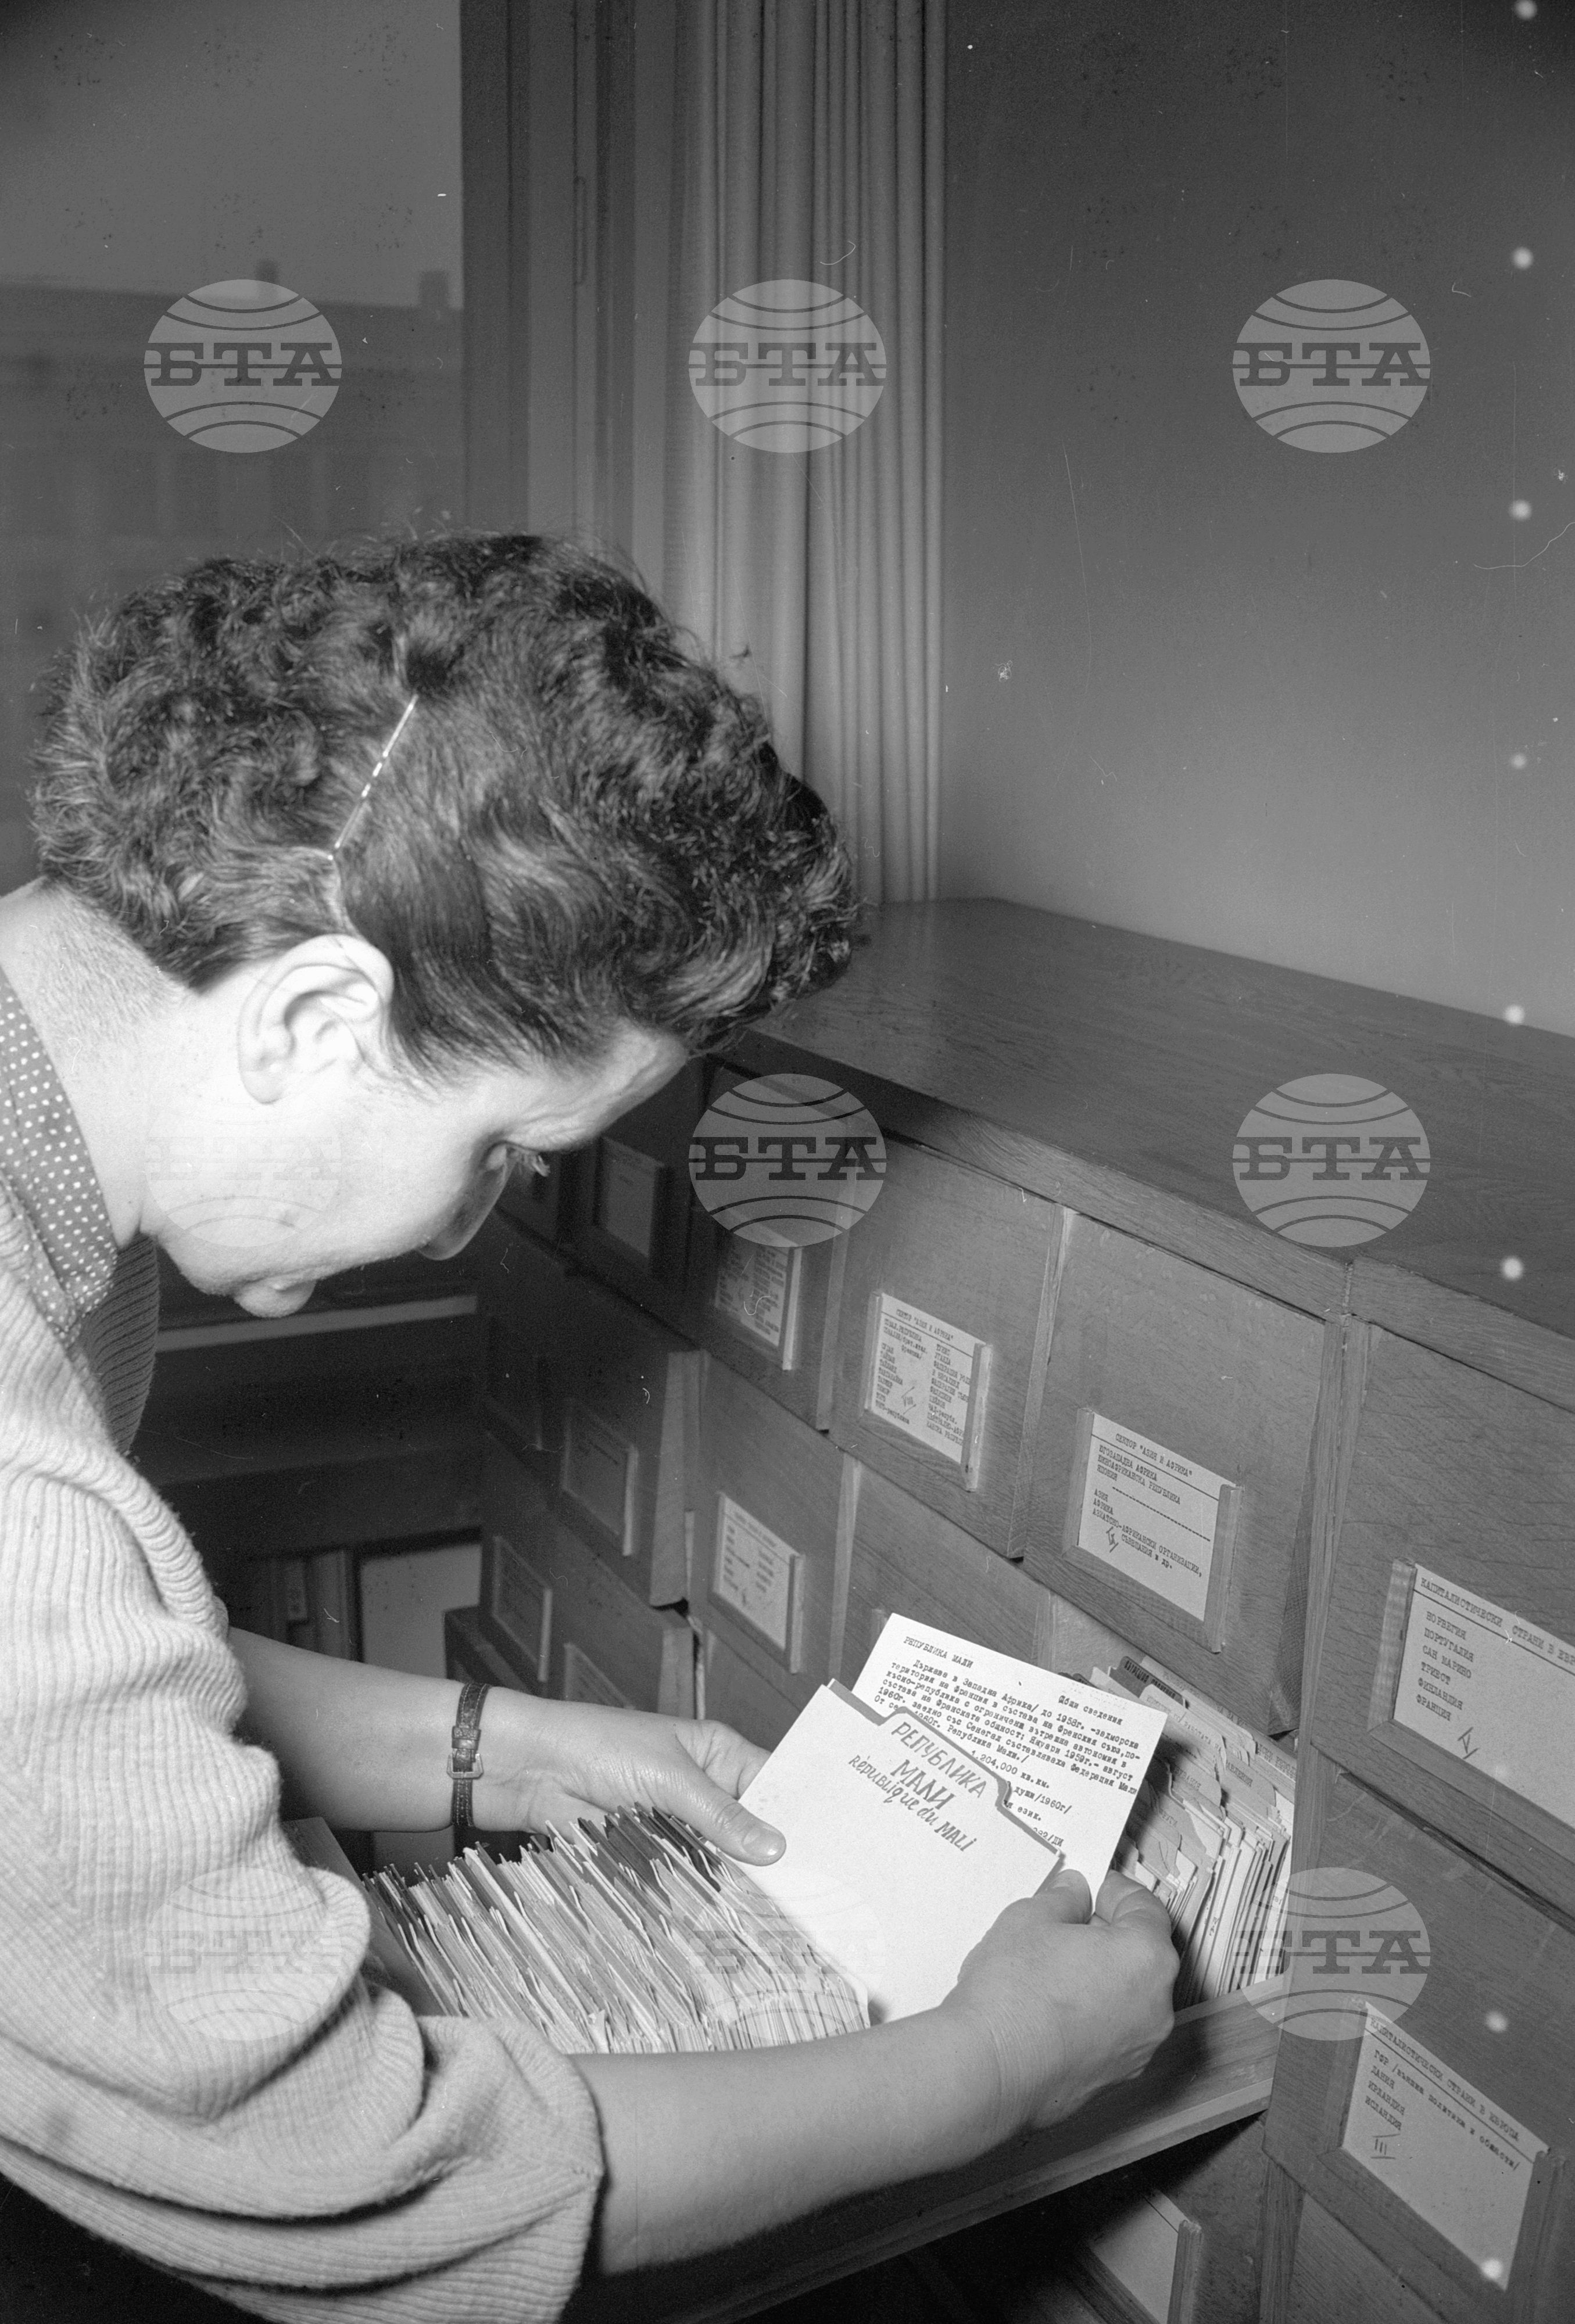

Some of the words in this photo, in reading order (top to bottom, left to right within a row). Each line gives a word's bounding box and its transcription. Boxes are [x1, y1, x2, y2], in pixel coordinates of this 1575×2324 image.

[1099, 1444, 1132, 1468] ЮГОЗАПАДНА
[1136, 1464, 1157, 1481] АФРИКА
[1115, 1433, 1136, 1449] СЕКТОР
[1166, 1459, 1191, 1476] АФРИКА"
[1097, 1464, 1117, 1481] ЯПОНИЯ
[1093, 1498, 1113, 1515] АФРИКА
[1094, 1489, 1108, 1502] АЗИЯ
[1148, 1481, 1180, 1504] РЕПУБЛИКА
[1159, 1545, 1201, 1577] ОРГАНИЗАЦИИ,
[1161, 1558, 1172, 1568] др.
[1420, 1577, 1502, 1627] КАПИТАЛИСТИЧЕСКИ
[1512, 1625, 1544, 1649] СТРАНИ
[1547, 1643, 1553, 1654] В
[1426, 1611, 1466, 1640] НОРВЕГИЯ
[1423, 1645, 1437, 1660] САН
[1441, 1655, 1471, 1678] МАРИНО
[1424, 1627, 1473, 1662] ПОРТУГАЛИЯ
[903, 1636, 947, 1658] РЕПУБЛИКА
[951, 1655, 973, 1667] МАЛИ
[1083, 1706, 1122, 1725] сведения
[1421, 1662, 1450, 1685] ТРИЕСТ
[892, 1662, 935, 1683] територия
[954, 1685, 988, 1704] Франция
[1003, 1705, 1037, 1723] състава
[1042, 1720, 1053, 1729] на
[1057, 1725, 1097, 1745] Френския
[912, 1659, 947, 1677] Държава
[962, 1678, 997, 1697] Западна
[1001, 1693, 1039, 1712] Африка/
[1056, 1713, 1084, 1729] 1958г.
[1416, 1694, 1451, 1721] ФРАНЦИЯ
[1418, 1677, 1463, 1710] ФИНЛАНДИЯ
[874, 1695, 885, 1703] От
[947, 1724, 991, 1748] Република
[996, 1744, 1029, 1763] Мали./
[883, 1679, 916, 1697] състава
[985, 1720, 1024, 1740] общност;
[1029, 1736, 1060, 1753] Януари
[1102, 1766, 1133, 1781] август
[886, 1671, 960, 1703] късно-република
[1028, 1726, 1068, 1746] вътрешна
[1073, 1744, 1117, 1764] автономия
[878, 1687, 905, 1703] 1960г.
[912, 1701, 942, 1717] заедно
[946, 1715, 961, 1725] със
[966, 1722, 1001, 1742] Сенегал
[1005, 1739, 1065, 1767] съставляваха
[1071, 1763, 1114, 1786] Федерация
[1118, 1781, 1137, 1794] Мали
[891, 1722, 987, 1798] РЕПУБЛИКА
[890, 1759, 956, 1810] МАЛИ
[917, 1807, 939, 1826] du
[1018, 1806, 1041, 1820] език.
[1372, 2018, 1443, 2081] КАПИТАЛИСТИЧЕСКИ
[1447, 2079, 1475, 2107] СТРАНИ
[1479, 2104, 1485, 2114] В
[1374, 2049, 1388, 2065] ГФР
[1370, 2065, 1394, 2089] ДАНИЯ
[1365, 2096, 1401, 2131] ИСЛАНДИЯ
[1368, 2081, 1405, 2115] ИРЛАНДИЯ
